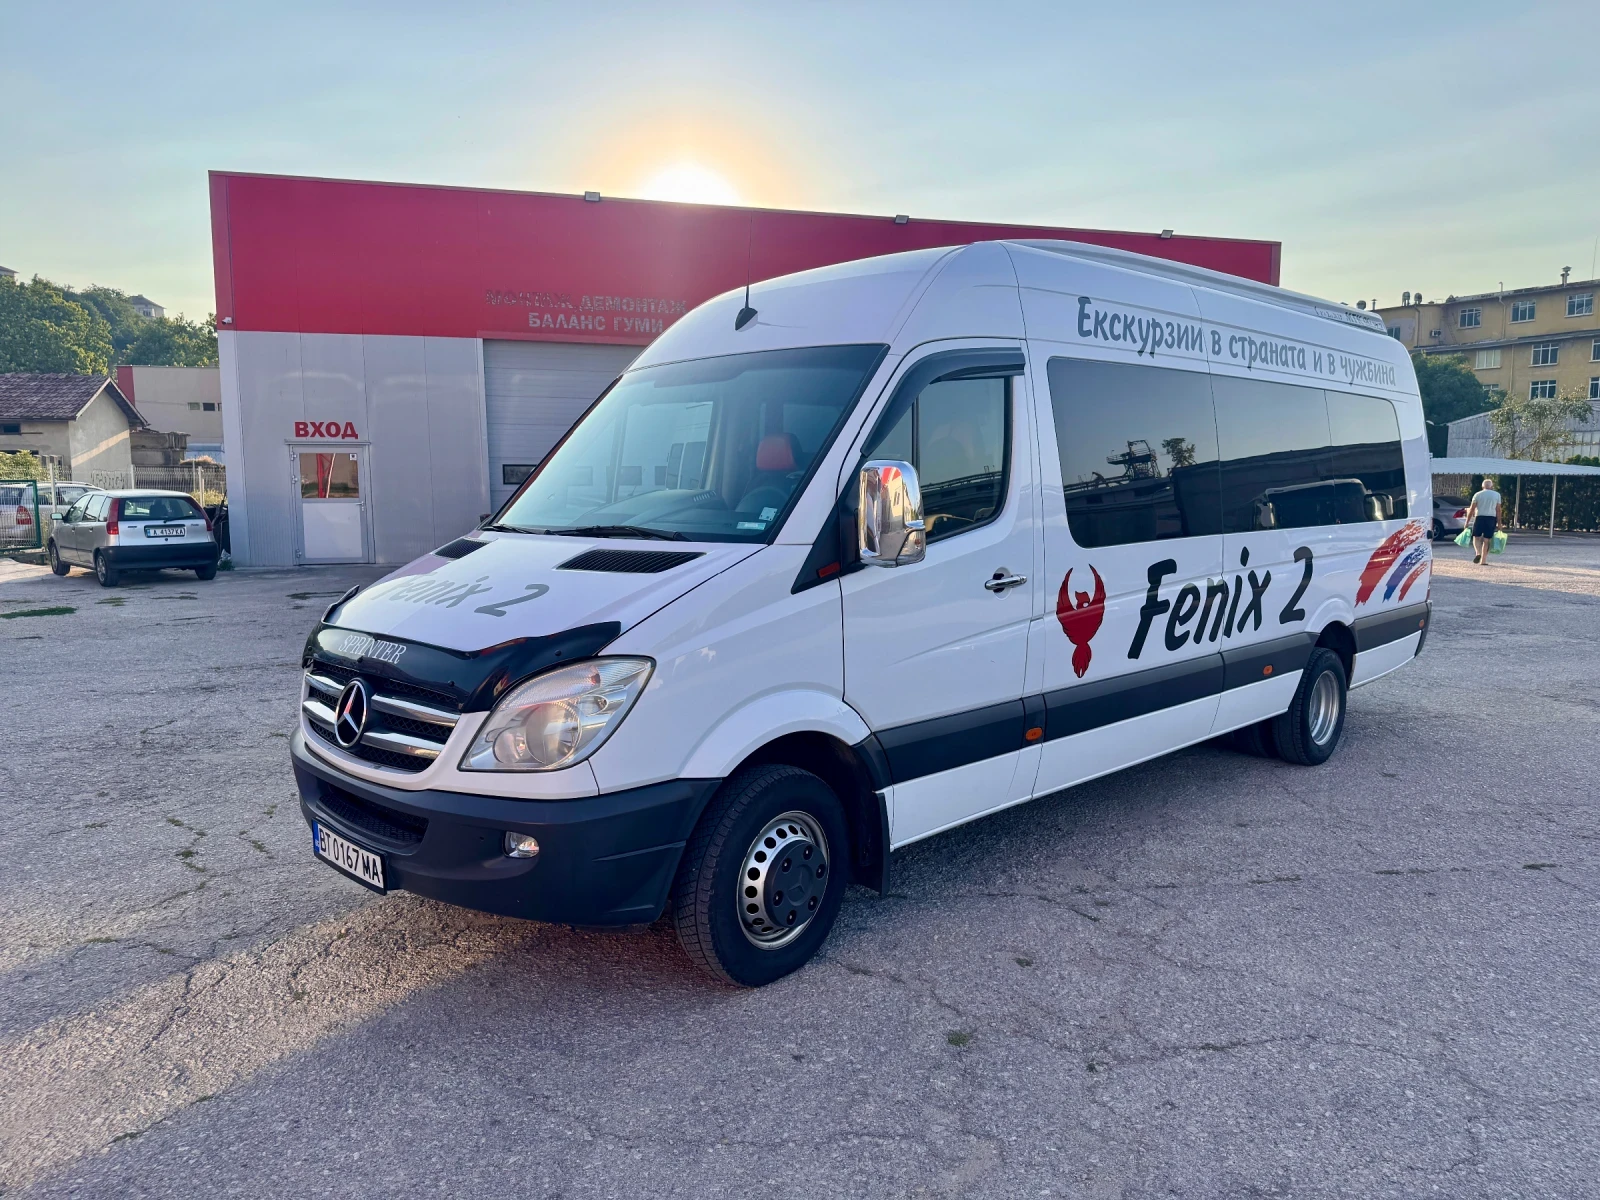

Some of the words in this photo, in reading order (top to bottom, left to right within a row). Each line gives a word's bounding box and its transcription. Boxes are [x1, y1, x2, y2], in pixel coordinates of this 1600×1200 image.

[528, 312, 606, 332] БАЛАНС
[613, 316, 664, 333] ГУМИ
[1077, 296, 1204, 359] Екскурзии
[1210, 330, 1222, 356] в
[1228, 334, 1306, 372] страната
[1313, 350, 1323, 374] и
[1327, 352, 1336, 376] в
[1340, 355, 1396, 387] чужбина
[294, 421, 359, 440] ВХОД
[474, 583, 550, 617] 2
[1127, 546, 1272, 660] Fenix
[1279, 545, 1314, 625] 2
[338, 634, 407, 664] SPRINTER
